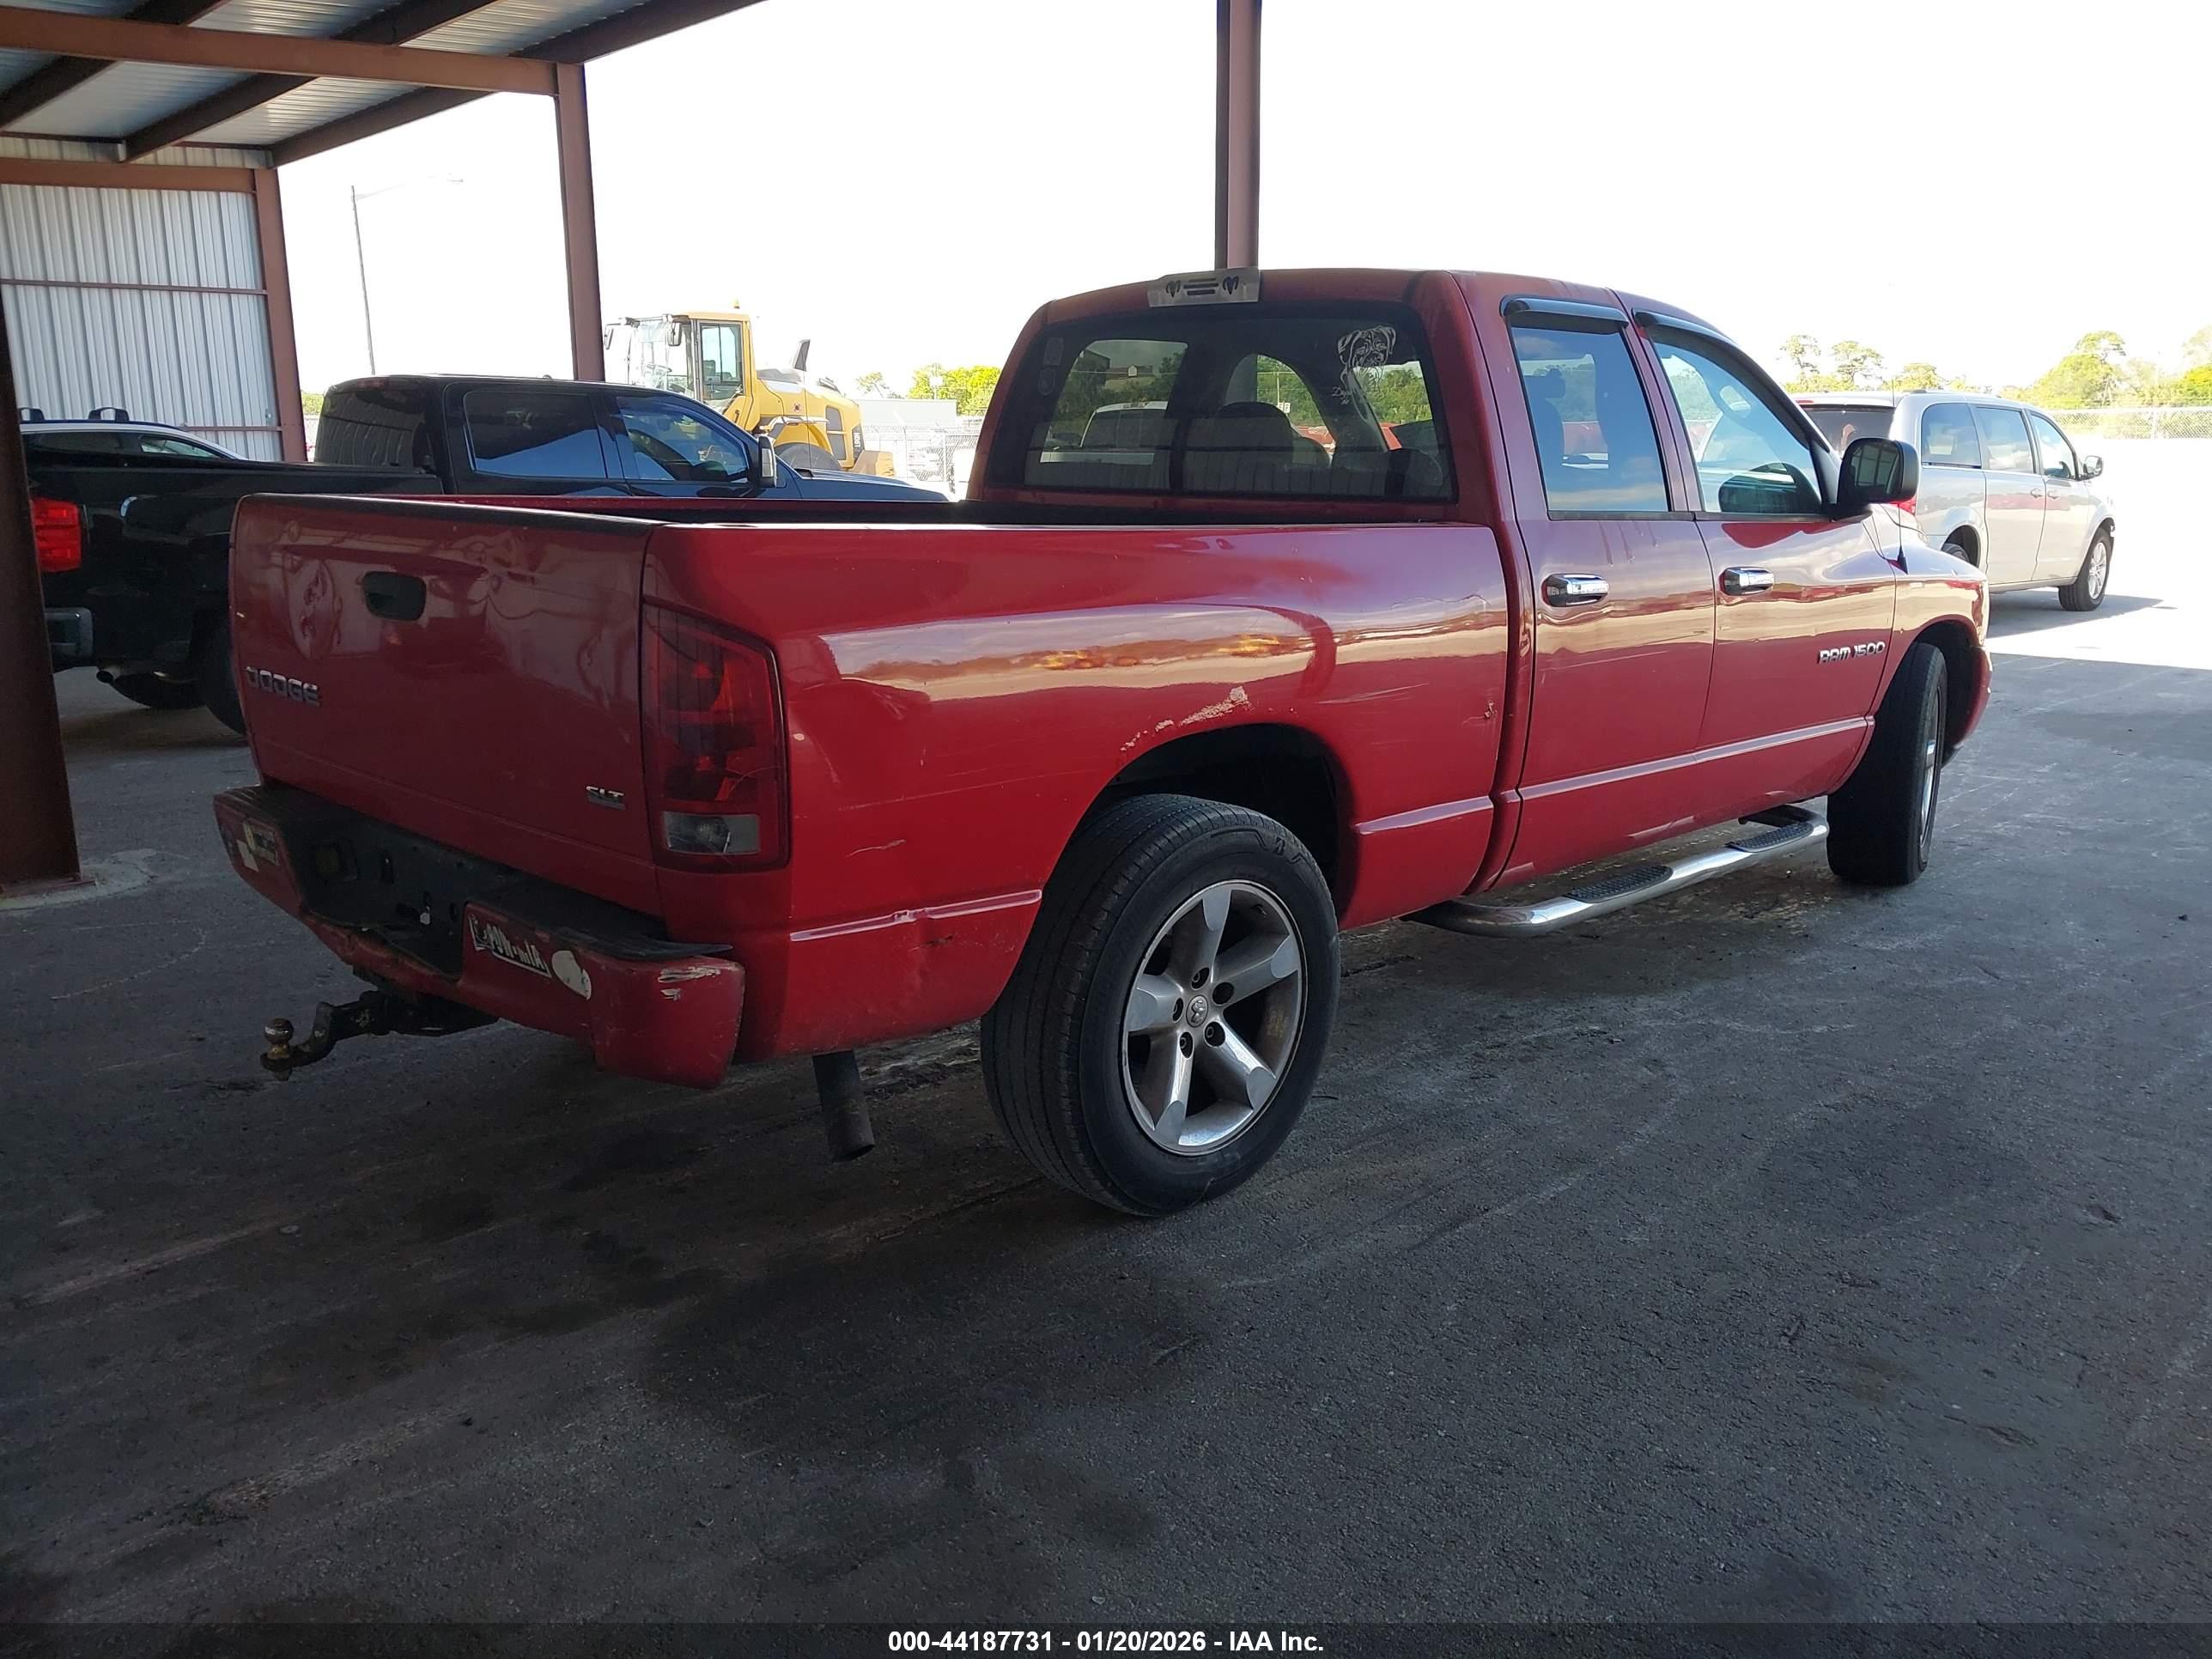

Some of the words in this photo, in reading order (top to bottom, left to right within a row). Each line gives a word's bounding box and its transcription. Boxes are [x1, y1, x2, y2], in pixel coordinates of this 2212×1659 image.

[1818, 647, 1851, 664] RAM
[1853, 641, 1886, 658] 1500
[246, 665, 319, 708] DODGE
[586, 785, 626, 811] SLT
